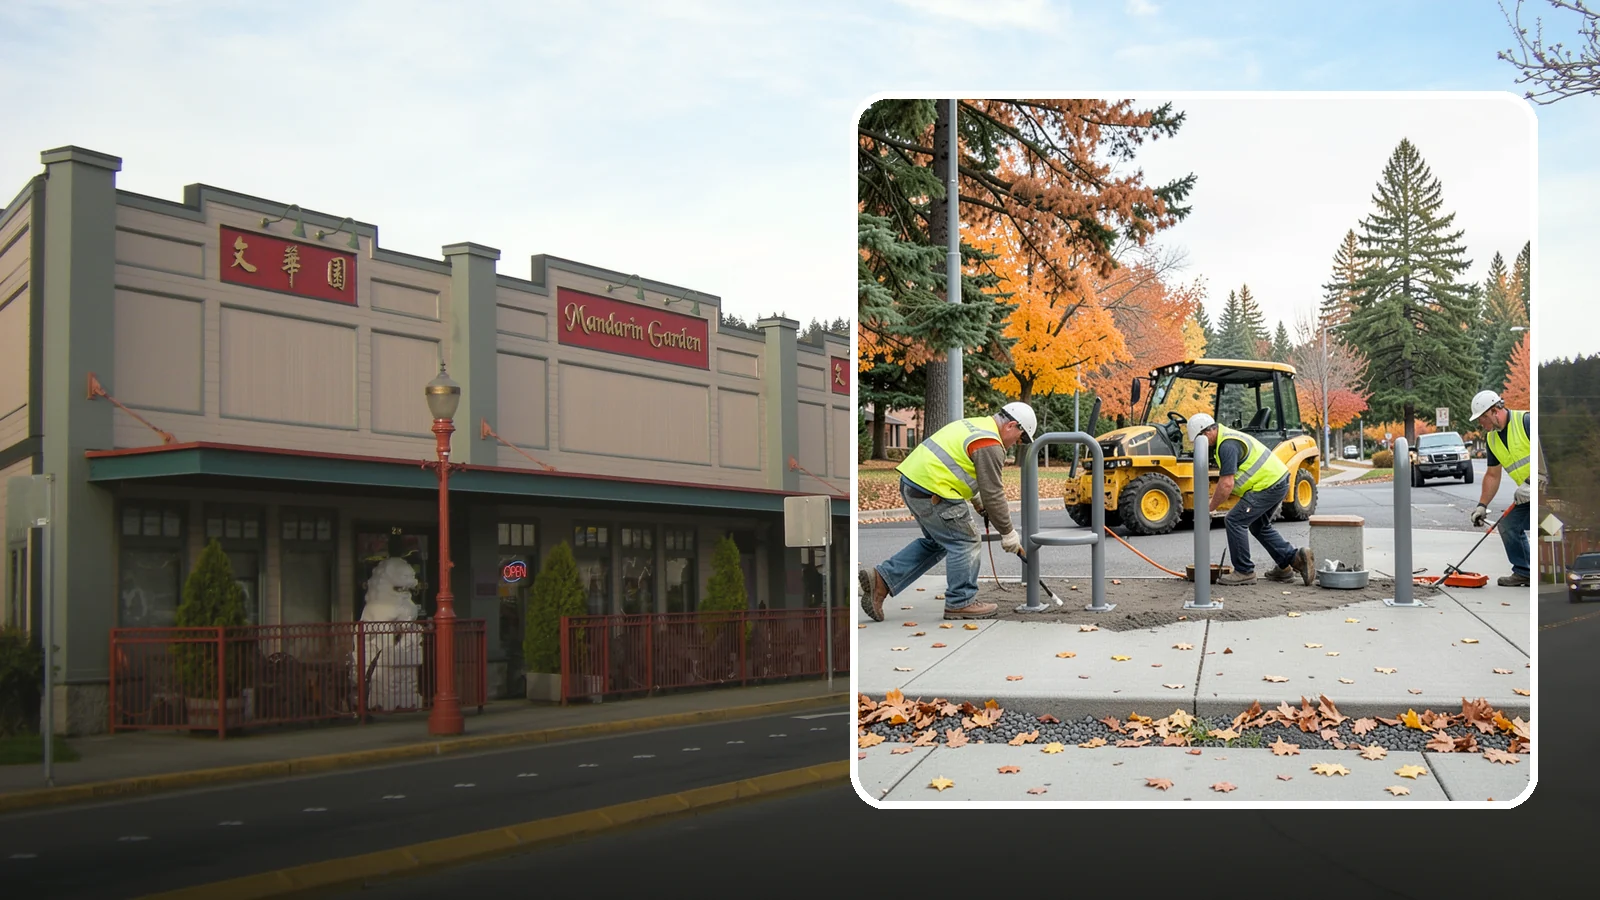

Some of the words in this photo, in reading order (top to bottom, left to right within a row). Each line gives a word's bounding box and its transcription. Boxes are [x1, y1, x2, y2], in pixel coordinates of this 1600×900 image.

[231, 235, 346, 291] 文華園
[564, 302, 644, 341] Mandarin
[648, 320, 701, 352] Garden
[503, 565, 527, 578] OPEN
